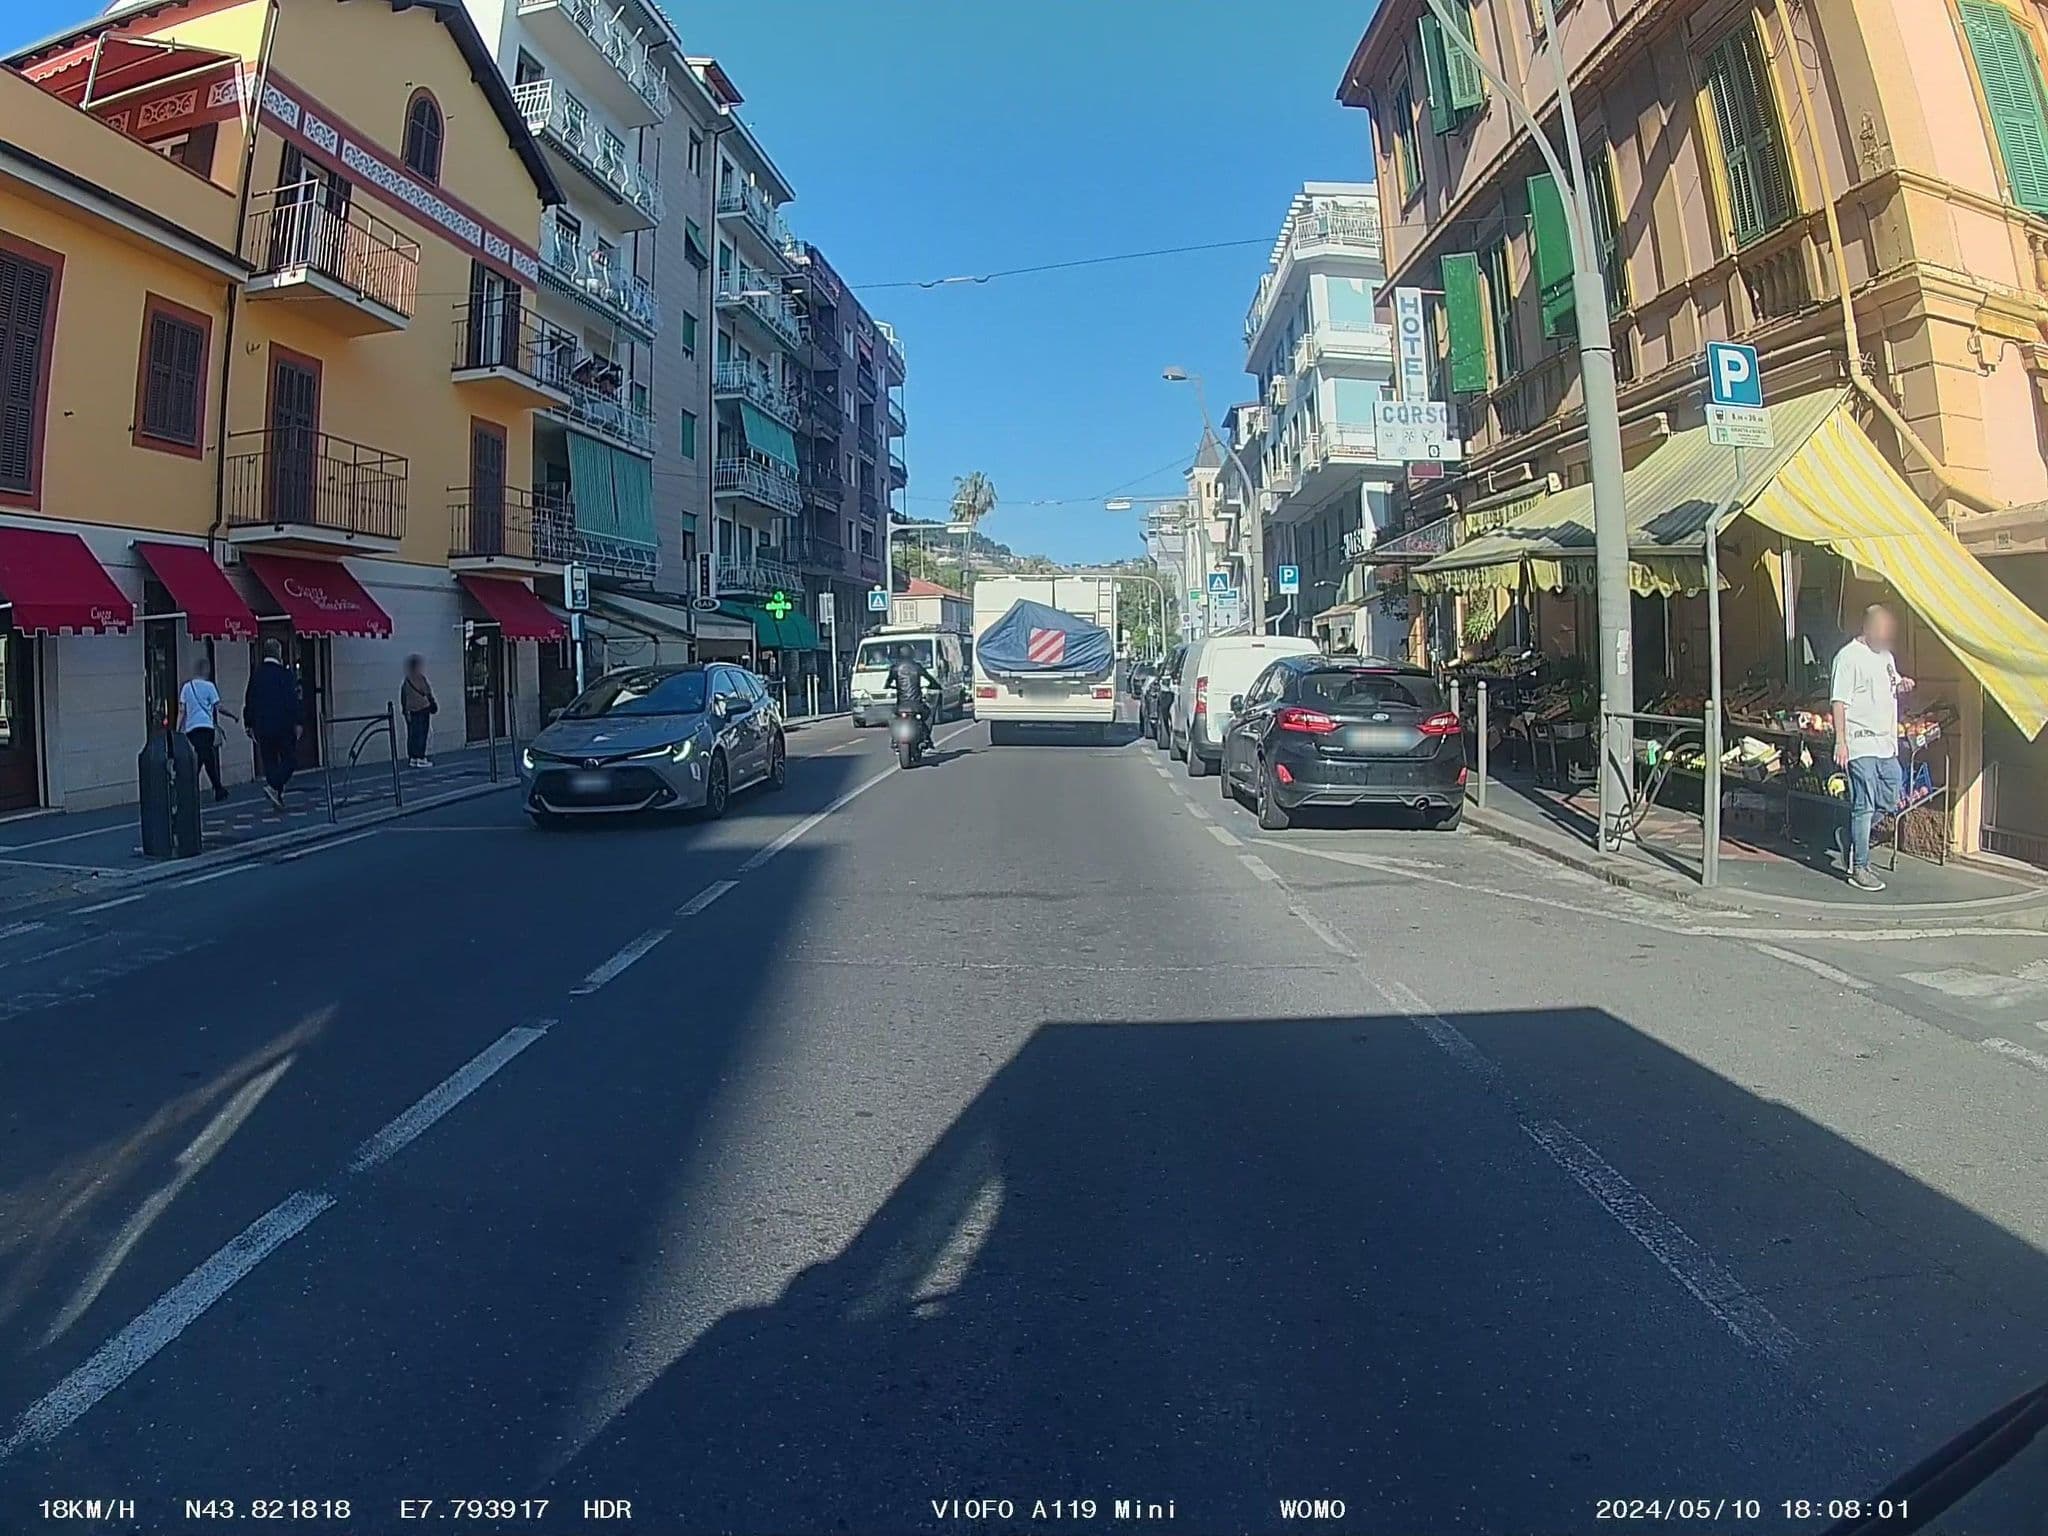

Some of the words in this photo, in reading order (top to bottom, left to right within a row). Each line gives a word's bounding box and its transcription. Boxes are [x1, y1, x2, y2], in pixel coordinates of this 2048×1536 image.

[1400, 297, 1424, 398] HOTEL
[1718, 348, 1750, 398] P
[1382, 405, 1450, 425] CORSO
